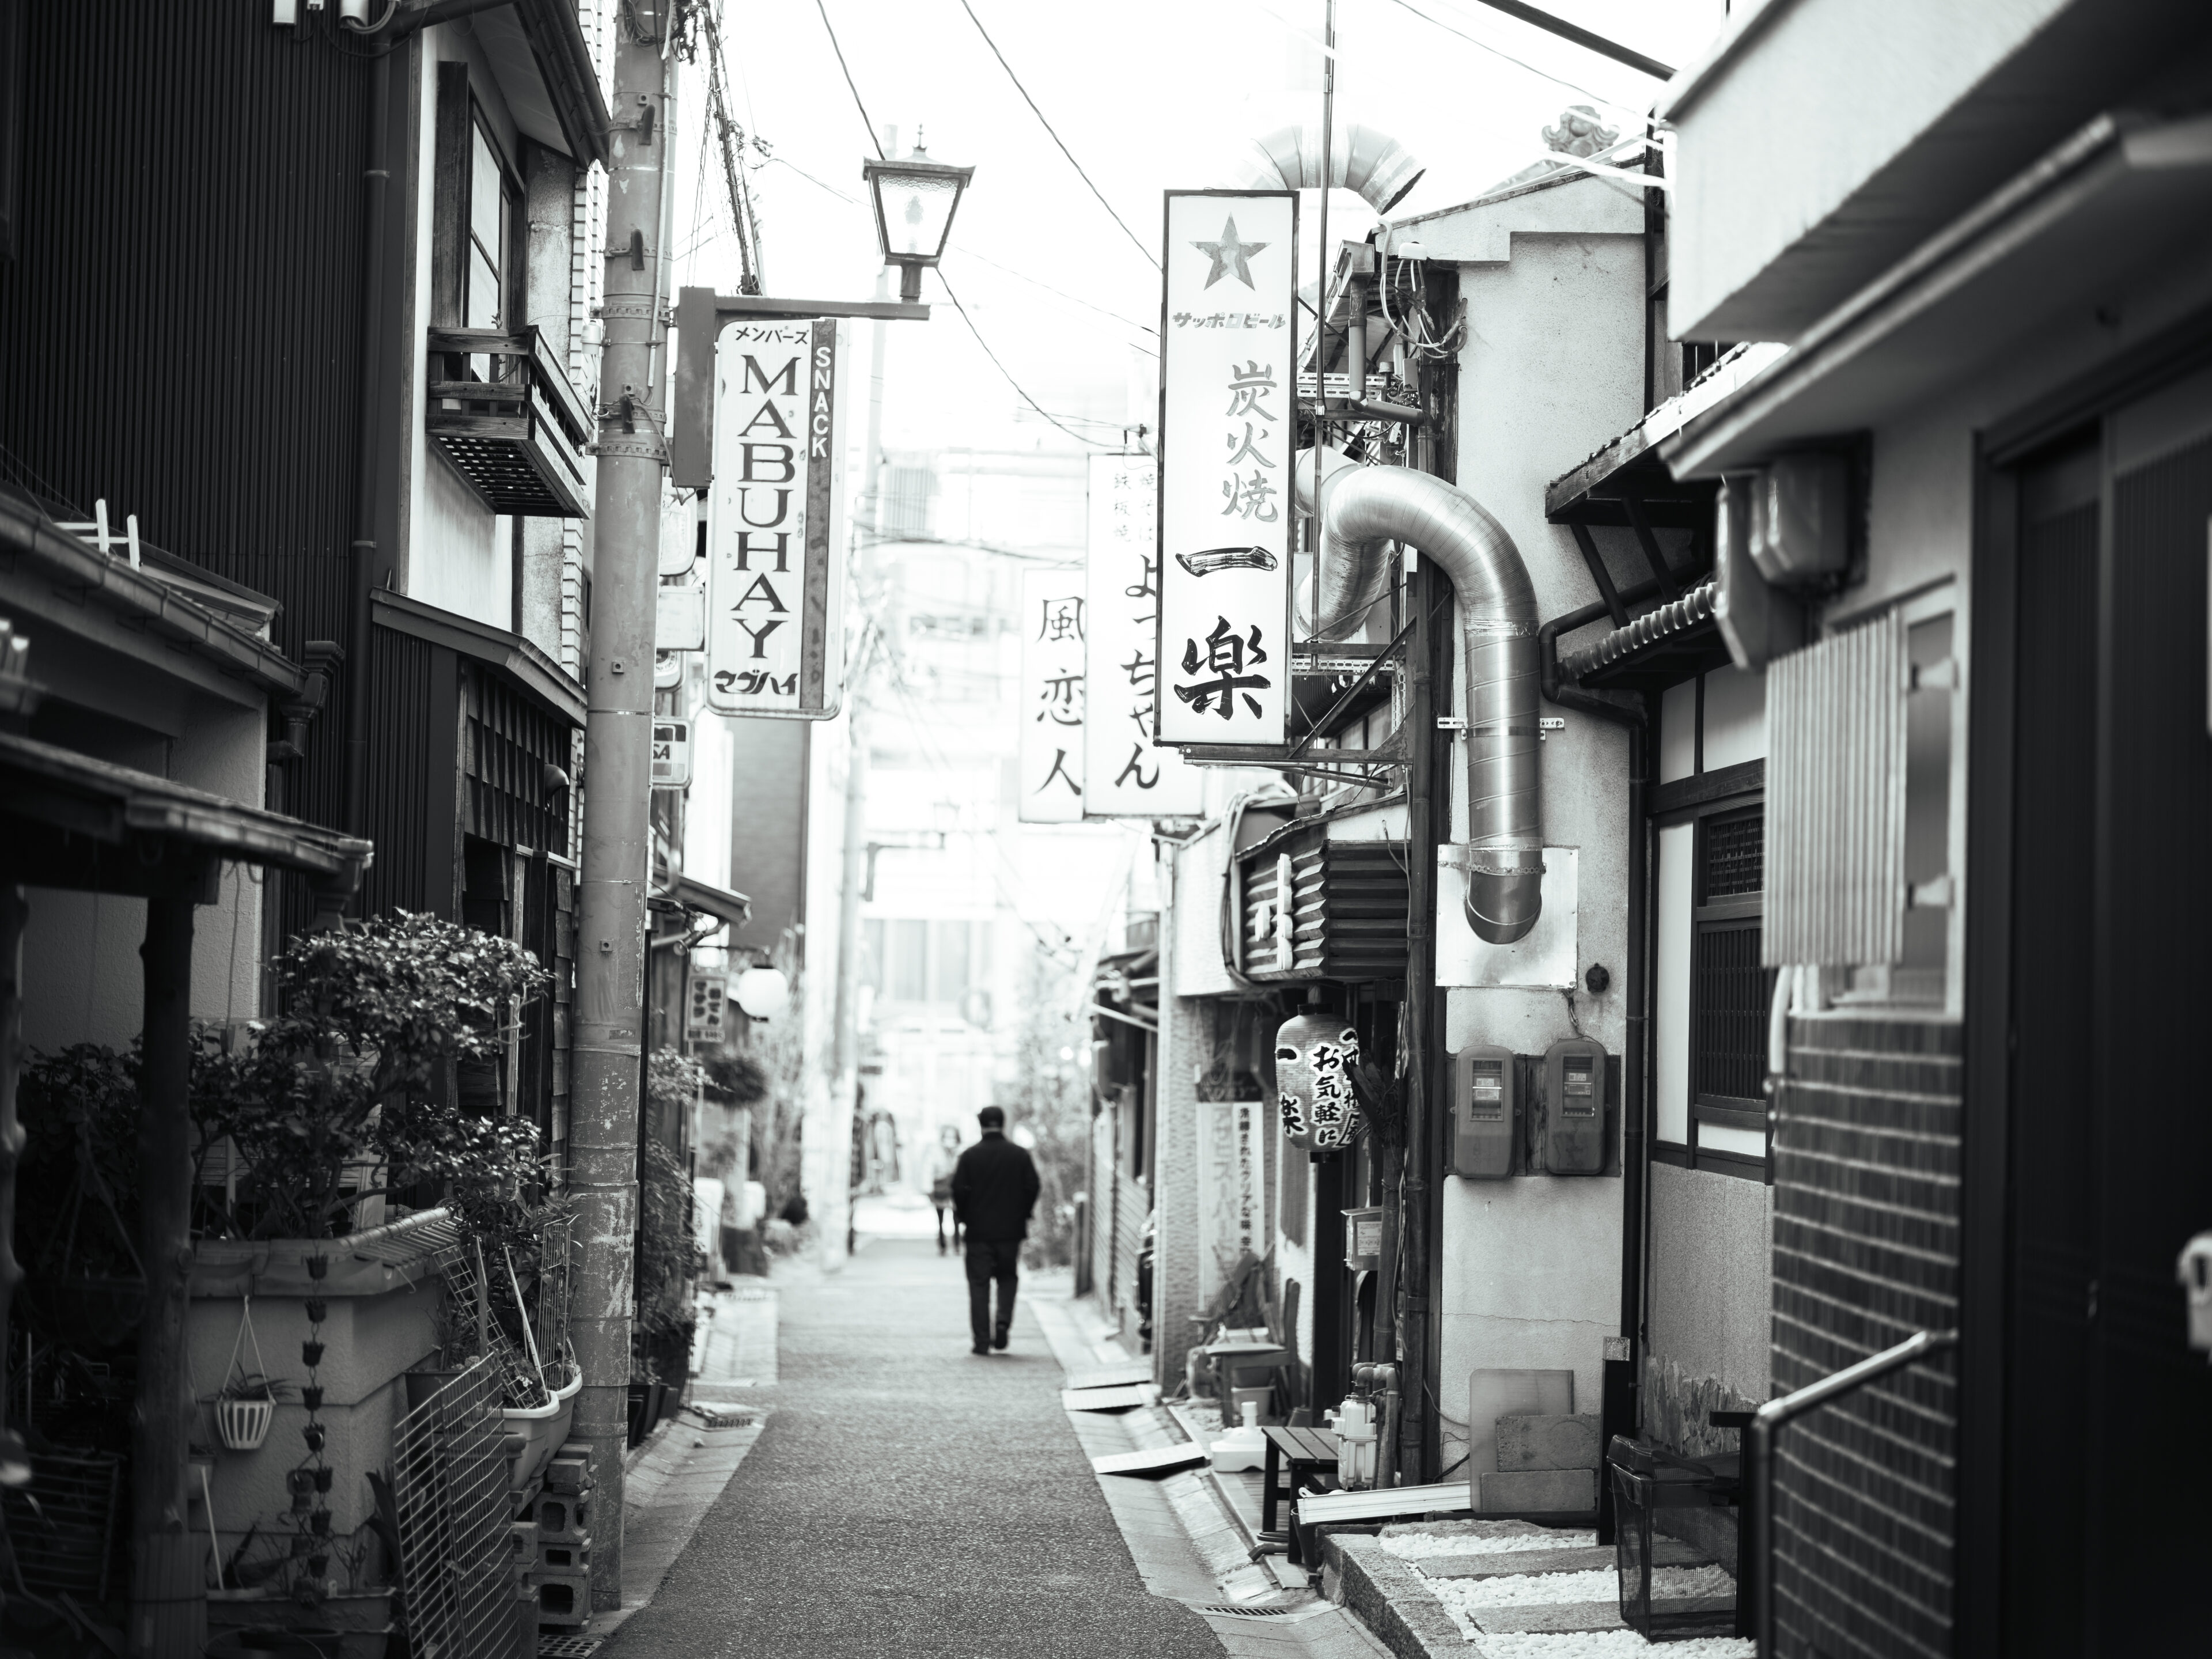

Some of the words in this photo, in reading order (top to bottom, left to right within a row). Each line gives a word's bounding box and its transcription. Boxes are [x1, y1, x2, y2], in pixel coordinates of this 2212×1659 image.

[734, 326, 808, 345] メンバーズ
[1172, 311, 1286, 329] サッポロビール
[810, 346, 831, 459] SNACK
[1221, 359, 1279, 522] 炭火焼
[730, 354, 802, 659] MABUHAY
[713, 669, 797, 696] マブハイ
[1173, 546, 1279, 721] 一楽
[1032, 595, 1085, 797] 風恋人
[1313, 1046, 1342, 1145] お気軽に
